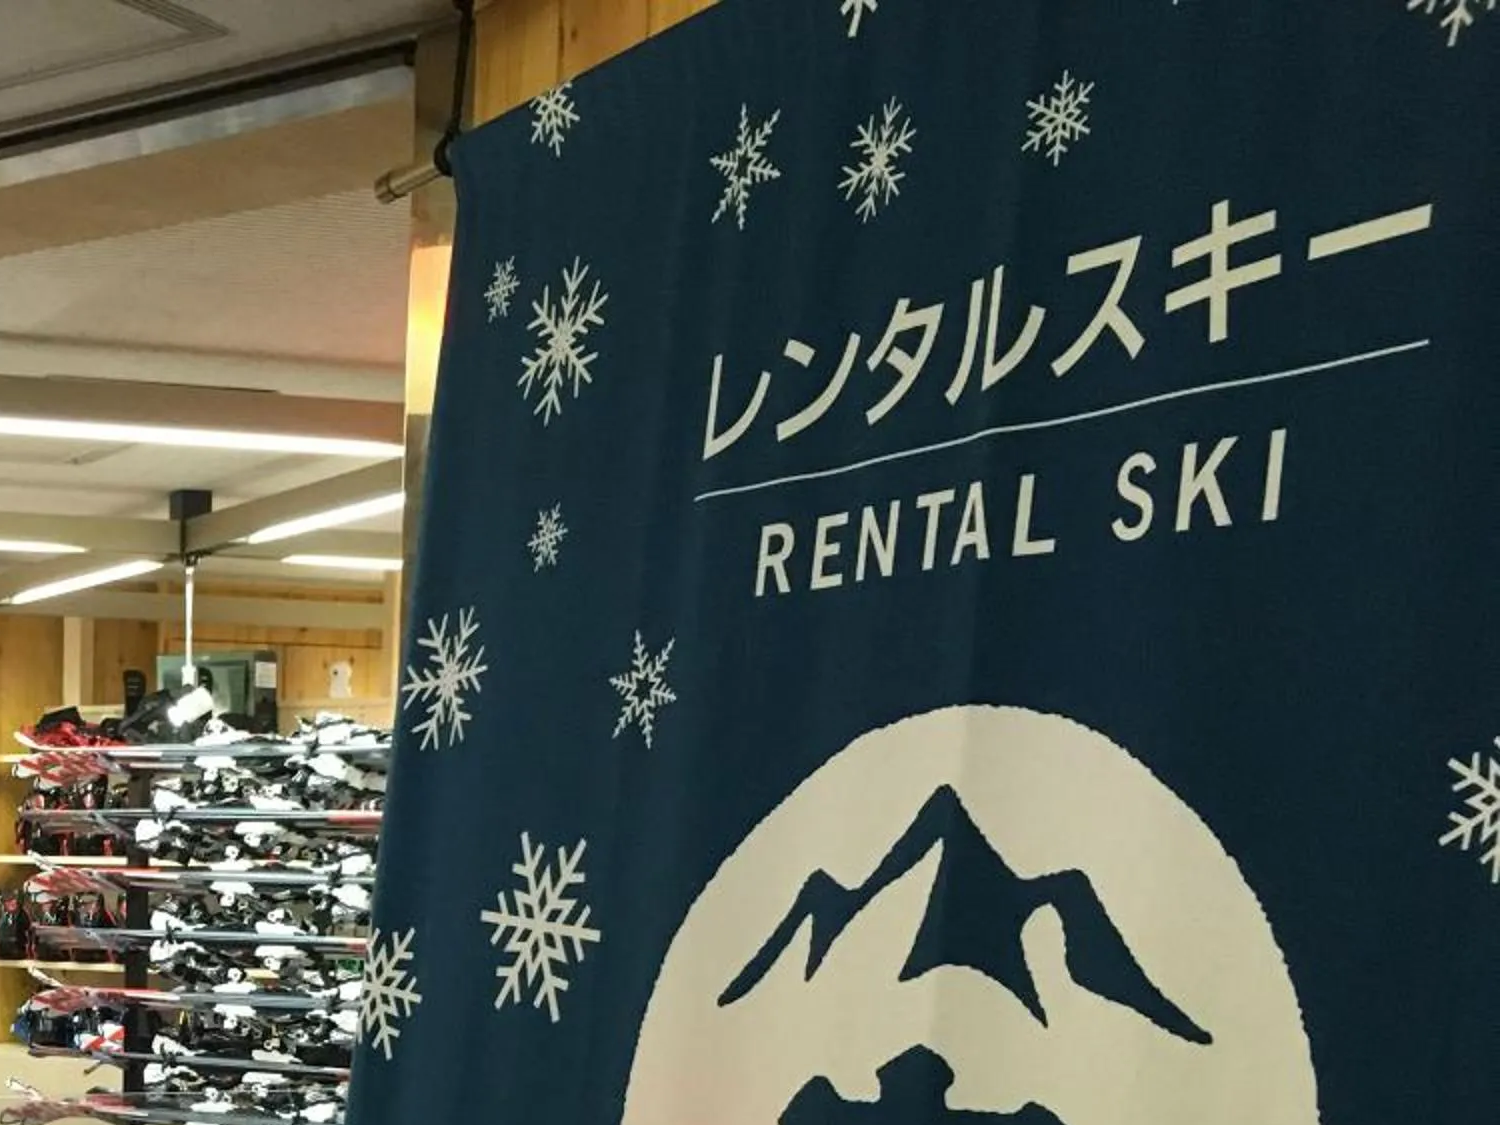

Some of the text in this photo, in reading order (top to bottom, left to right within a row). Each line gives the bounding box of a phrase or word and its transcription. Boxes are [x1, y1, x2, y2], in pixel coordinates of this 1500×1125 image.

[703, 200, 1432, 460] レンタルスキー
[754, 429, 1287, 597] RENTAL SKI
